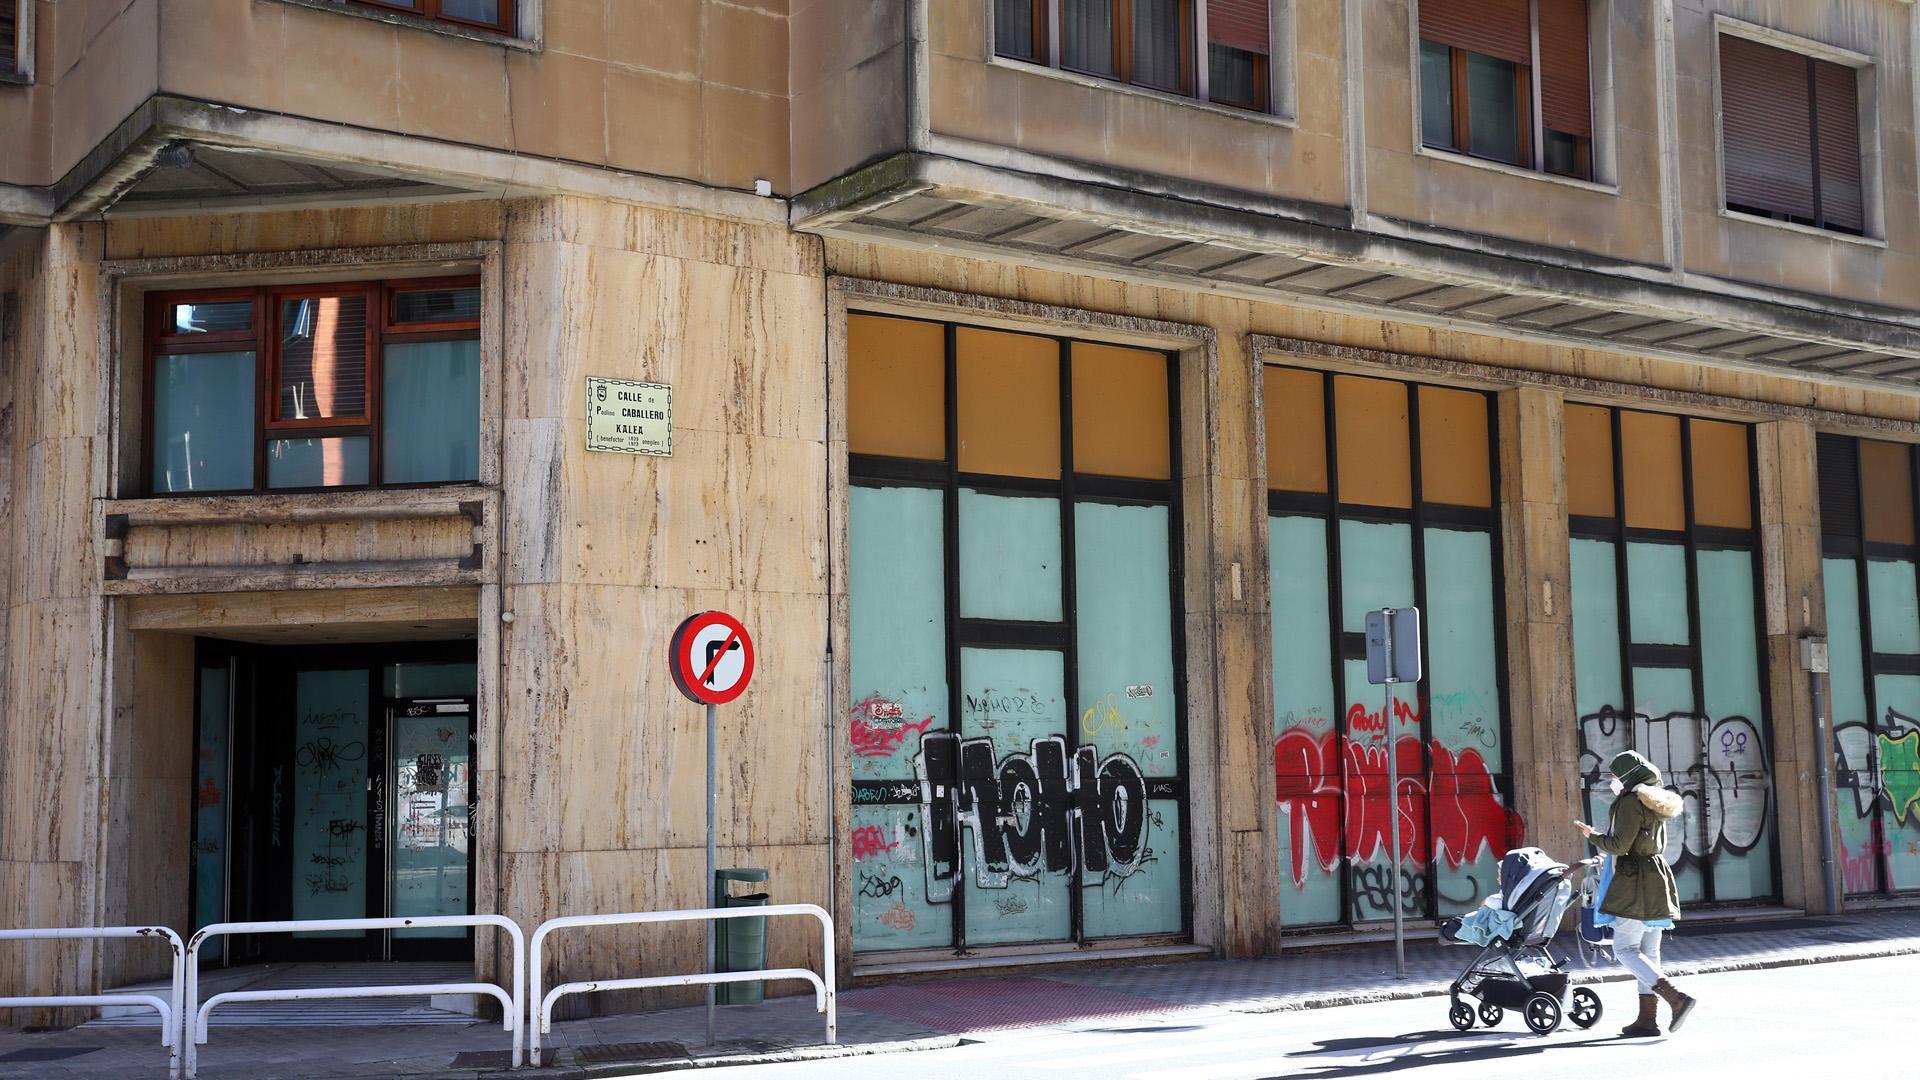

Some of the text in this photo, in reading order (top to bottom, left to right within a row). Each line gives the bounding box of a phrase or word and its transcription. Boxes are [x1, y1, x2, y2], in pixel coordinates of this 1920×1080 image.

[618, 391, 642, 402] CALLE
[622, 408, 664, 420] CABALLERO
[616, 424, 644, 435] KALEA
